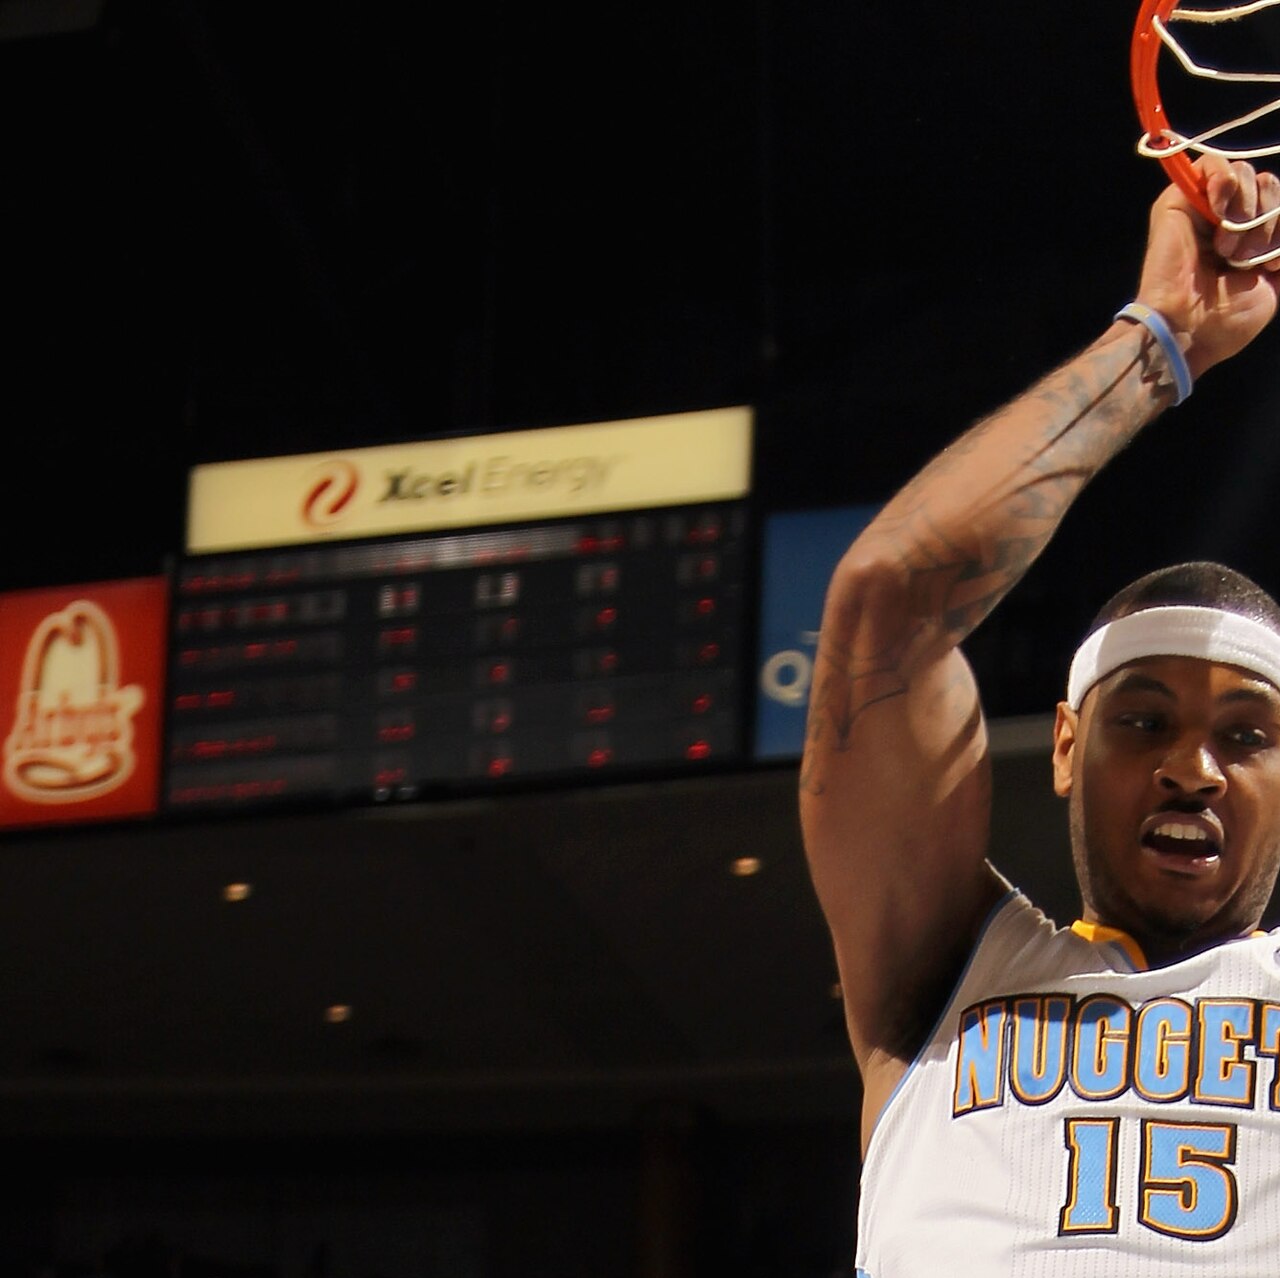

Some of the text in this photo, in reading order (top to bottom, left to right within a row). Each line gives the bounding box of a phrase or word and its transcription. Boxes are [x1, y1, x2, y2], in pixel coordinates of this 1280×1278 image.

[378, 452, 632, 504] Xcel Energy
[1058, 1116, 1239, 1241] 15
